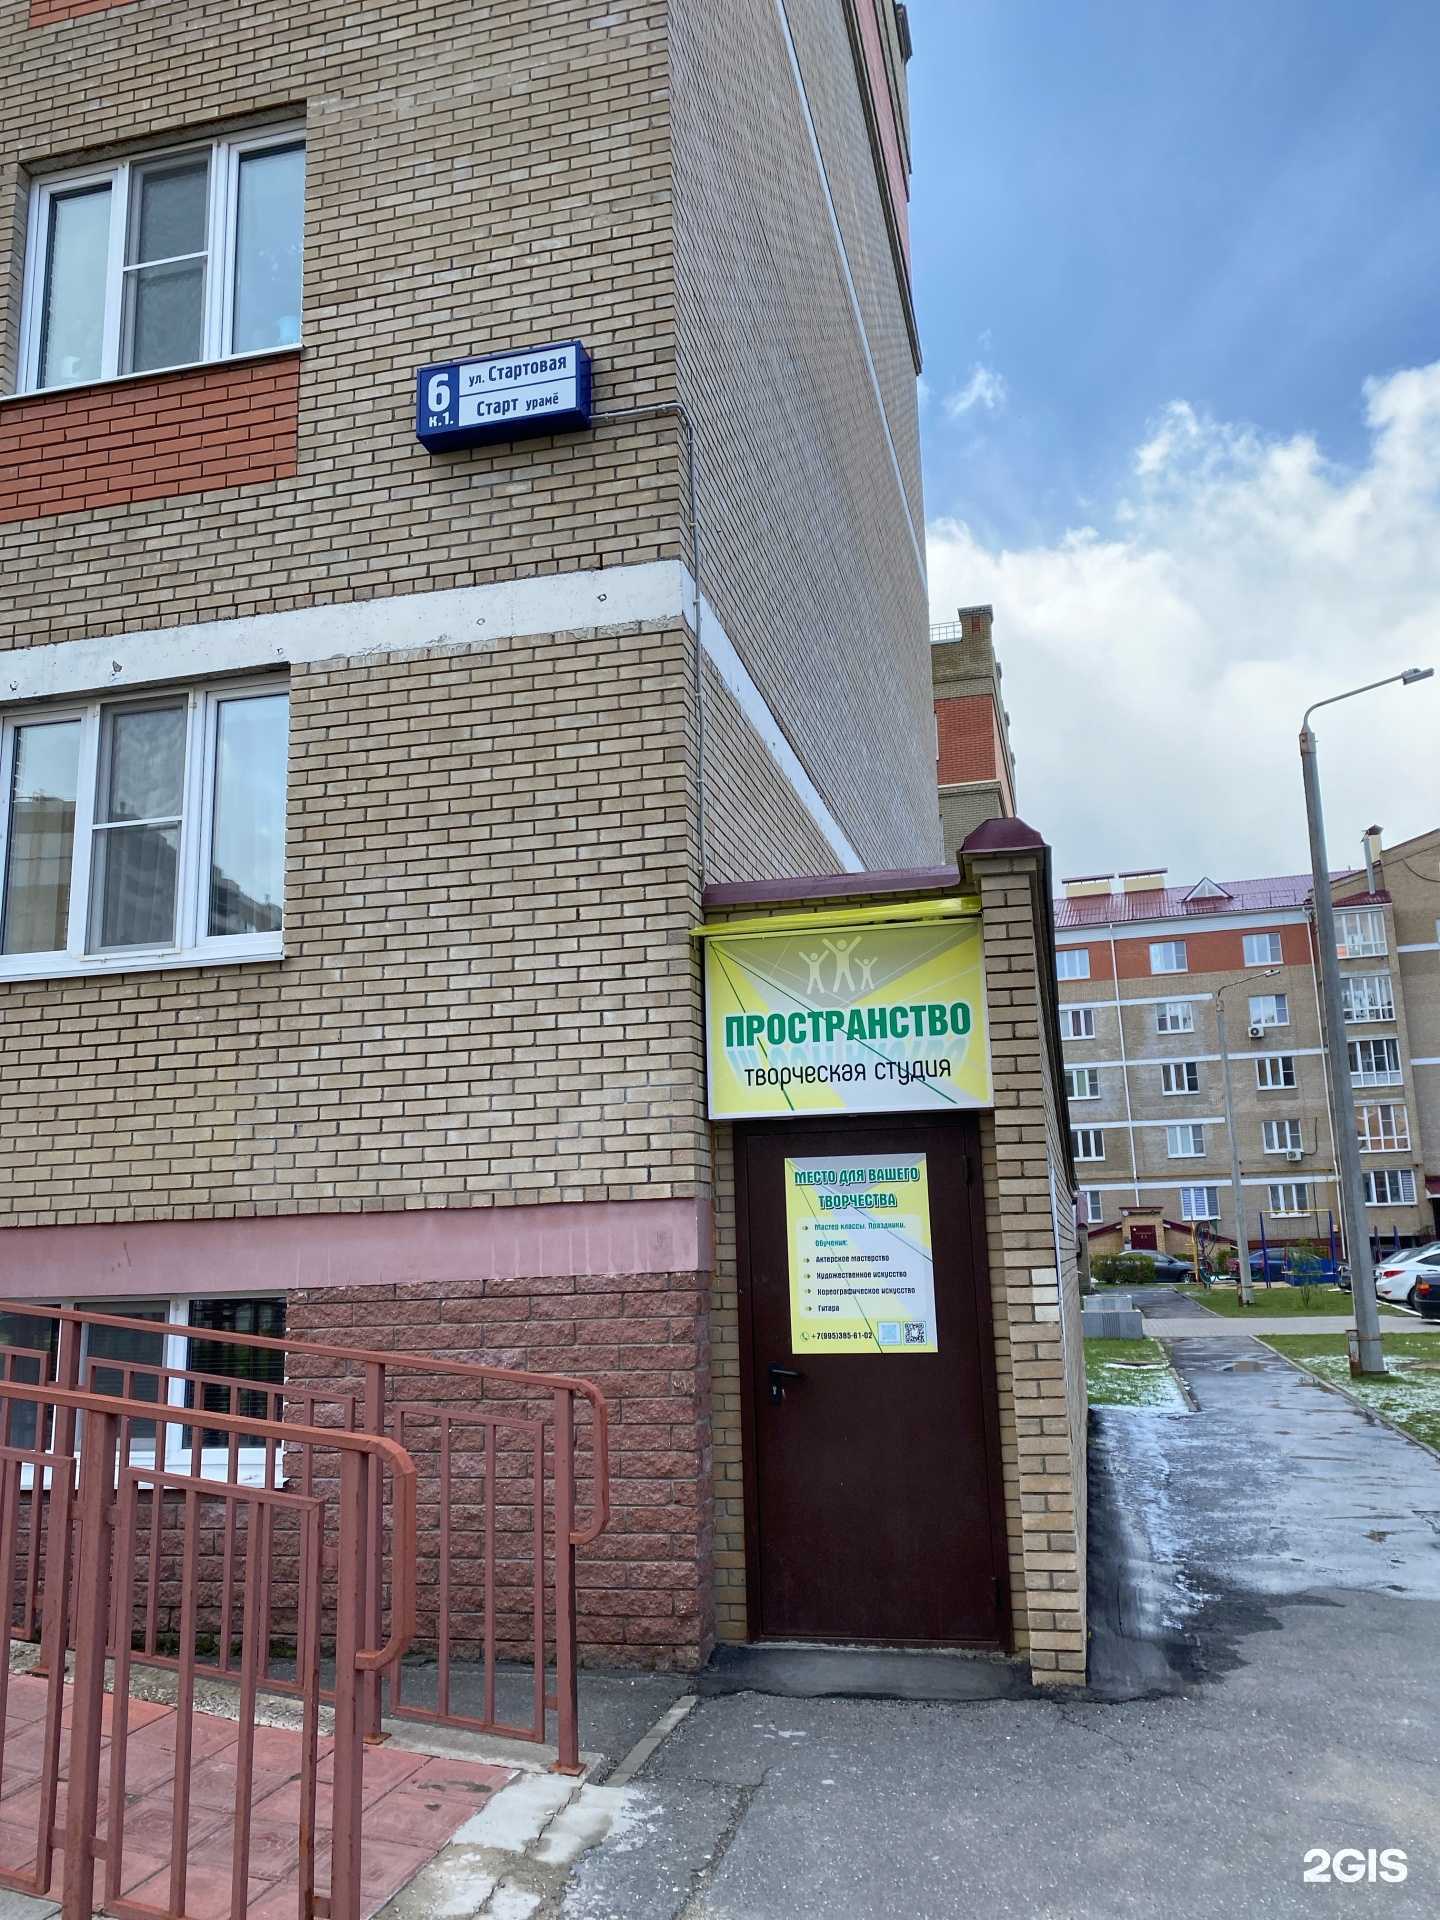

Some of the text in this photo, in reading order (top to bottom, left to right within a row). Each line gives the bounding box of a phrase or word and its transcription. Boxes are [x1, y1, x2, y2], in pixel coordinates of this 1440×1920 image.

[468, 356, 567, 387] ул. Стартовая
[427, 373, 451, 412] 6
[476, 398, 519, 416] Старт
[725, 1002, 972, 1048] ПРОСТРАНСТВО
[744, 1058, 952, 1090] творческая студия
[795, 1167, 920, 1186] МЕСТО ДЛЯ ВАШЕГО
[818, 1193, 898, 1210] ТВОРЧЕСТВА
[850, 1255, 890, 1263] мастерство
[816, 1270, 907, 1280] Художественное искусство
[817, 1287, 916, 1296] Хореографическое искусство
[818, 1304, 840, 1313] Гитара
